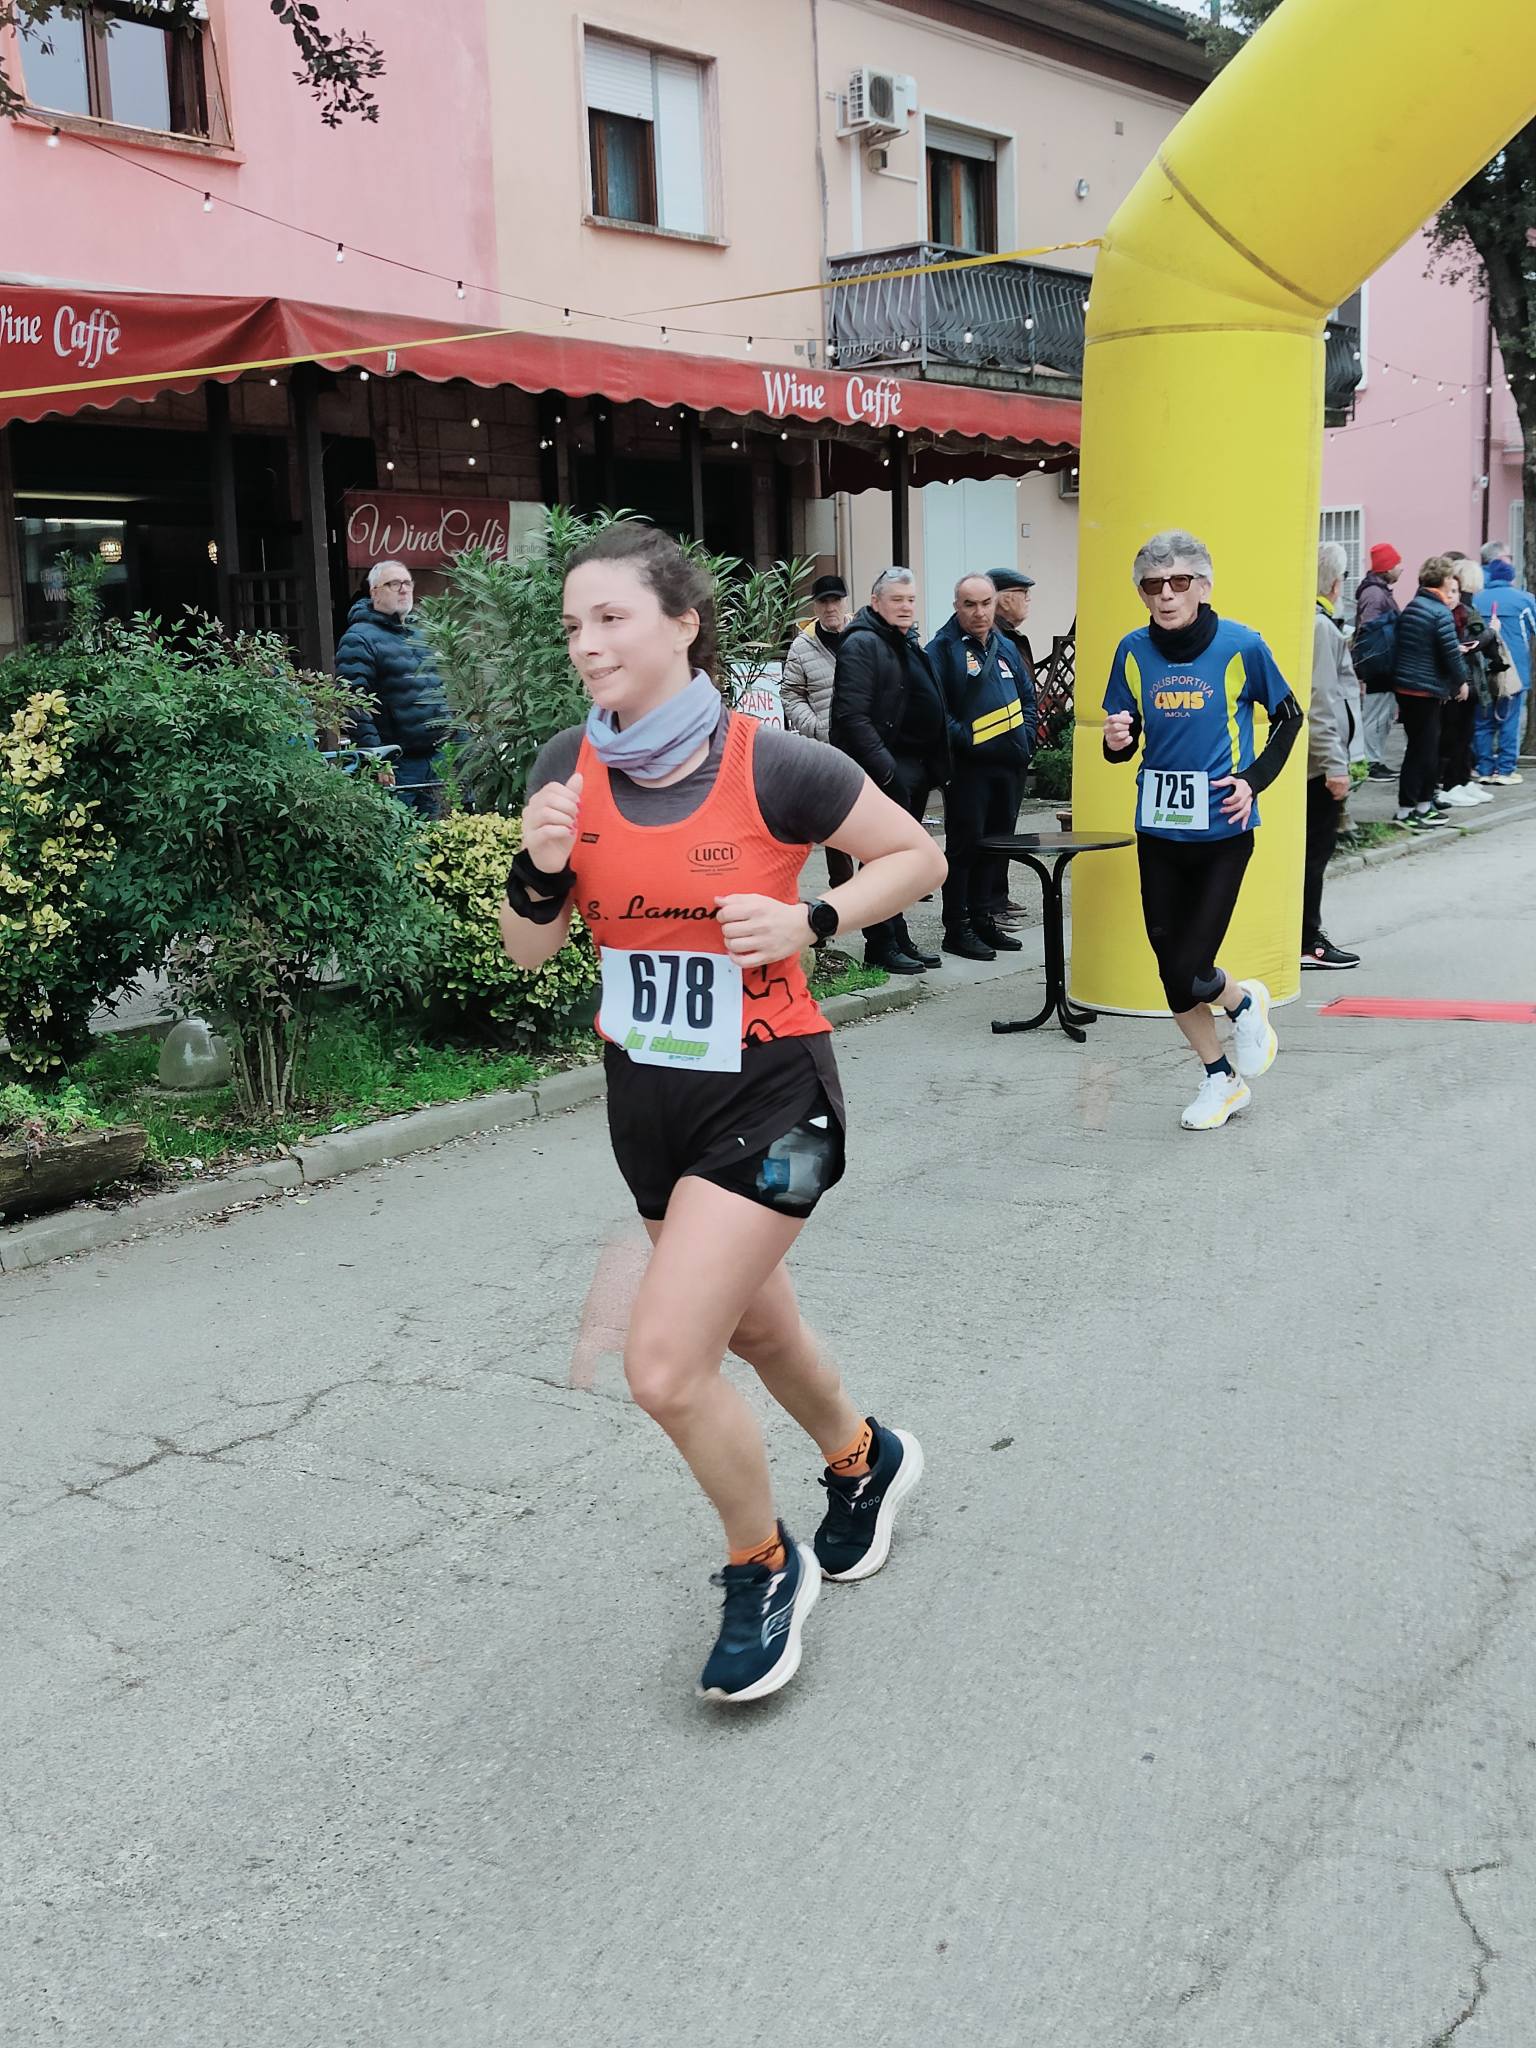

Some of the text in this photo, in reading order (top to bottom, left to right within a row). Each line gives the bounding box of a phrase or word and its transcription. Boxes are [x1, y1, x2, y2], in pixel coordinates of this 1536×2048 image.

[53, 305, 120, 368] Caffè
[762, 371, 902, 427] Wine Caffè
[741, 691, 774, 712] PANE
[1149, 675, 1214, 699] POLISPORTIVA
[1154, 691, 1205, 710] AVIS
[1154, 773, 1195, 810] 725
[695, 847, 734, 862] LUCCI
[629, 953, 714, 1030] 678
